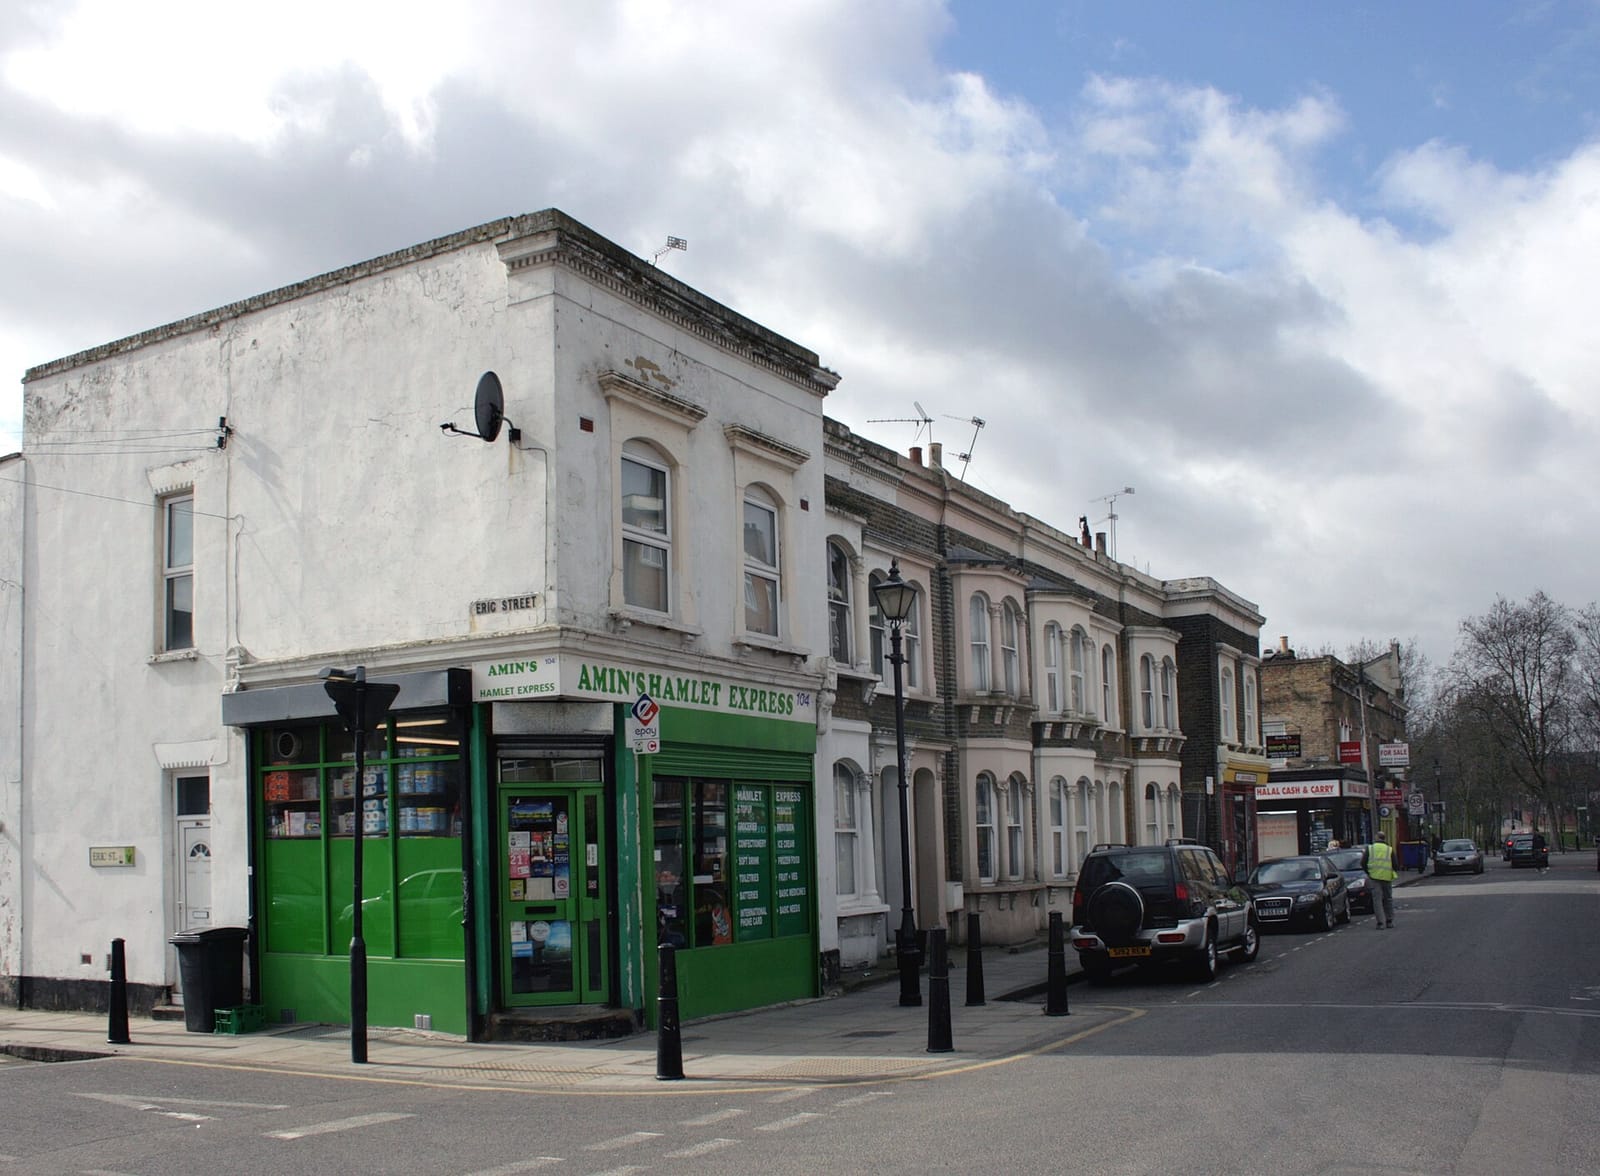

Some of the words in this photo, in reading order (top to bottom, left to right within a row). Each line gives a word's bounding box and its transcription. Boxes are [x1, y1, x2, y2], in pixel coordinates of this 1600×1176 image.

[475, 601, 497, 614] ERIC
[502, 596, 537, 611] STREET
[488, 660, 538, 676] AMIN'S
[480, 687, 515, 698] HAMLET
[518, 682, 555, 694] EXPRESS
[578, 664, 645, 697] AMIN'S
[648, 674, 721, 706] HAMLET
[729, 685, 794, 715] EXPRESS
[796, 692, 810, 707] 104
[635, 728, 657, 737] epay
[737, 790, 762, 801] HAMLET
[1257, 787, 1280, 796] HALAL
[1282, 786, 1300, 794] CASH
[1311, 785, 1334, 793] CARRY
[776, 791, 800, 802] EXPRESS
[739, 856, 748, 865] SOFT
[778, 872, 788, 881] FRUIT
[740, 890, 759, 900] BATTERIES
[779, 888, 789, 898] BASIC
[740, 906, 767, 917] INTERNATIONAL
[779, 905, 789, 914] BASIC
[740, 917, 752, 927] PHONE
[753, 916, 763, 926] CARD
